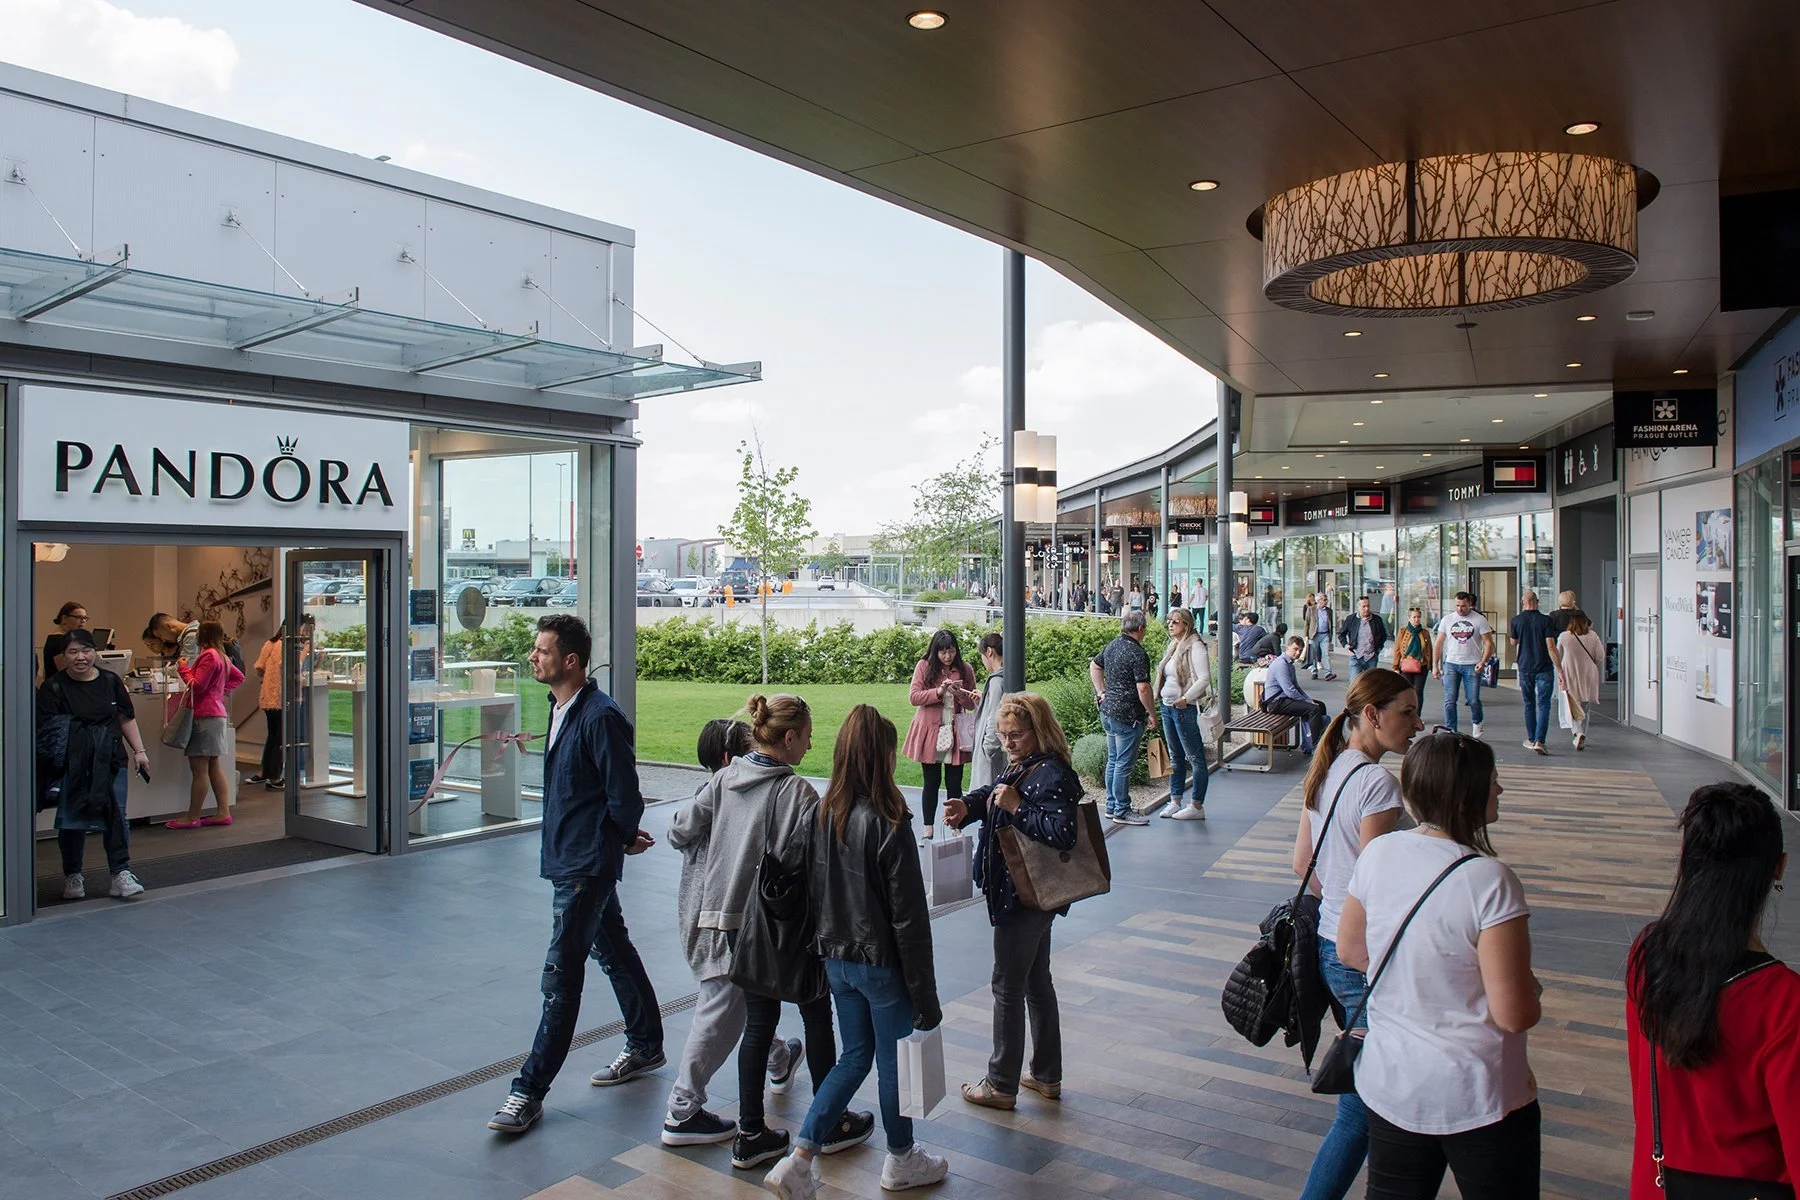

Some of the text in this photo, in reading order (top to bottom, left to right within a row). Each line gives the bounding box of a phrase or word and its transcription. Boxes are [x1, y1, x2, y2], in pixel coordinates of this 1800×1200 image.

[1633, 424, 1668, 432] FASHION
[56, 439, 394, 507] PANDORA
[1448, 484, 1481, 501] TOMMY
[1303, 509, 1328, 521] TOMMY
